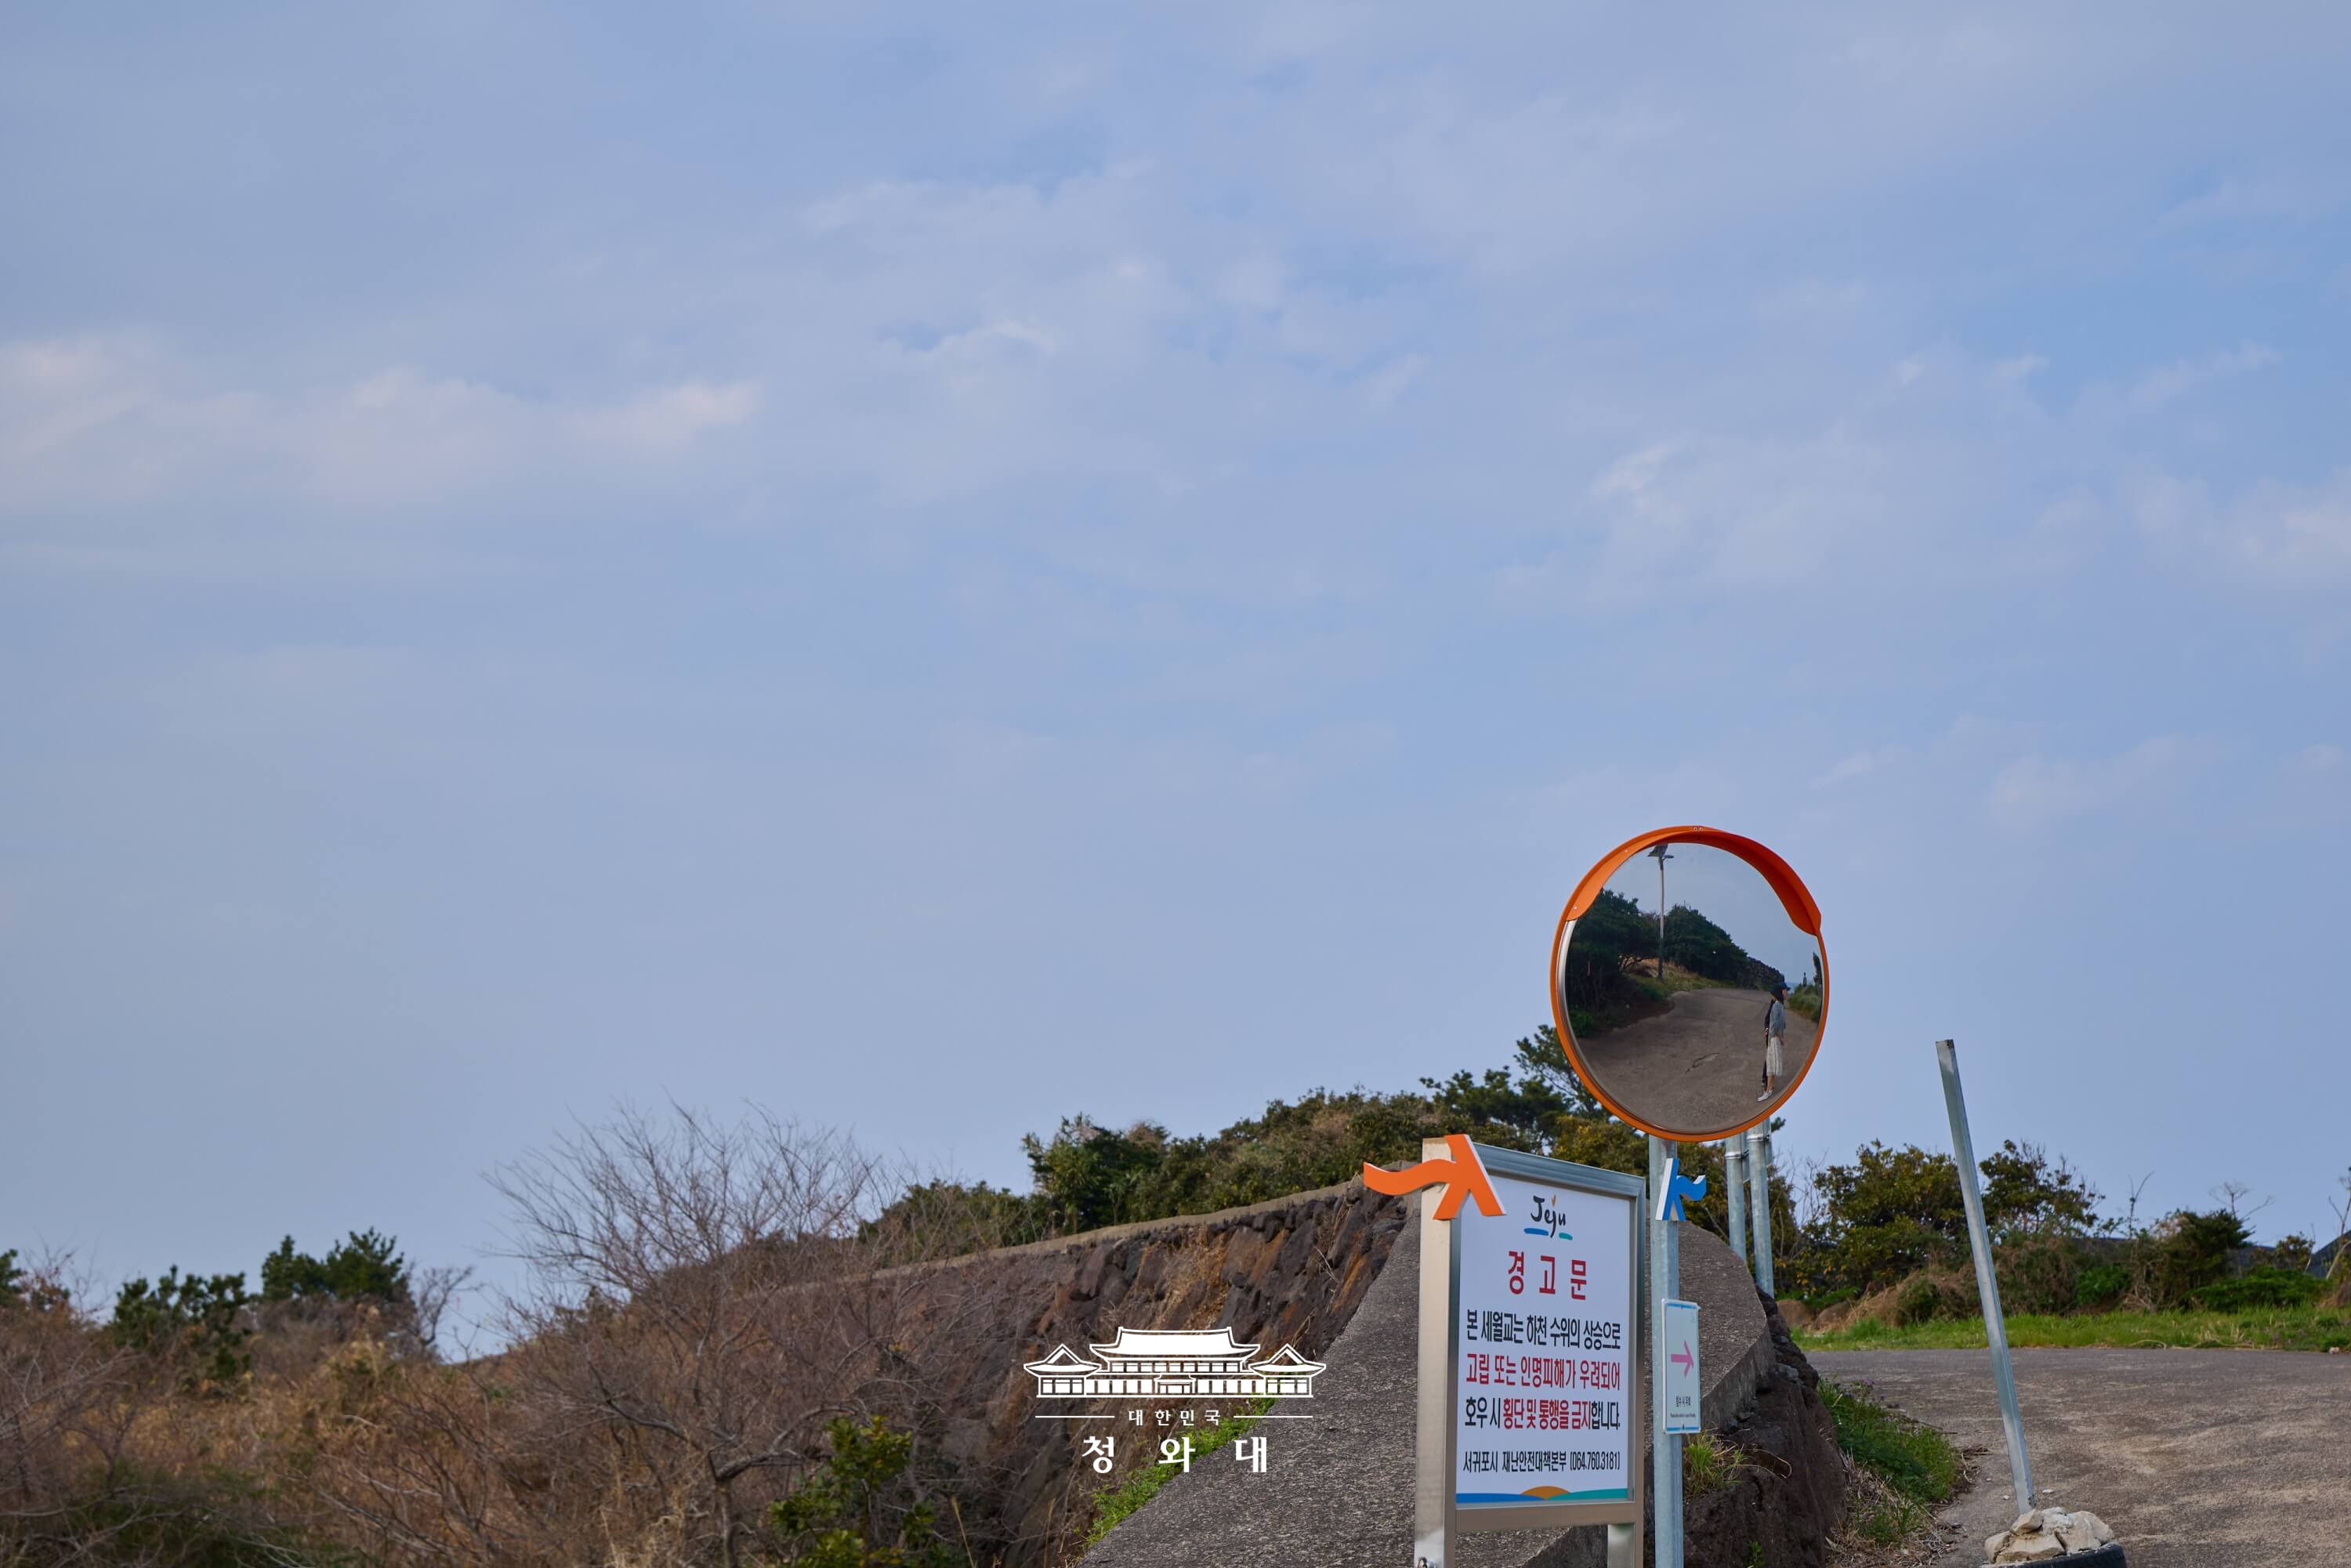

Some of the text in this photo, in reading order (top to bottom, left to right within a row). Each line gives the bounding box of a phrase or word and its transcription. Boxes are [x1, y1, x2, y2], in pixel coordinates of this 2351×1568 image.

[1530, 1194, 1567, 1238] Jeju
[1507, 1250, 1587, 1301] 경고문
[1466, 1309, 1621, 1351] 본 세월교는 하천 수위의 상승으로
[1466, 1353, 1620, 1391] 고립 또는 인명피해가 우려되어
[1465, 1396, 1621, 1430] 호우 시 횡단 및 통행을 금지합니다.
[1463, 1450, 1498, 1473] 서귀포시
[1502, 1450, 1567, 1472] 재난안전대책본부
